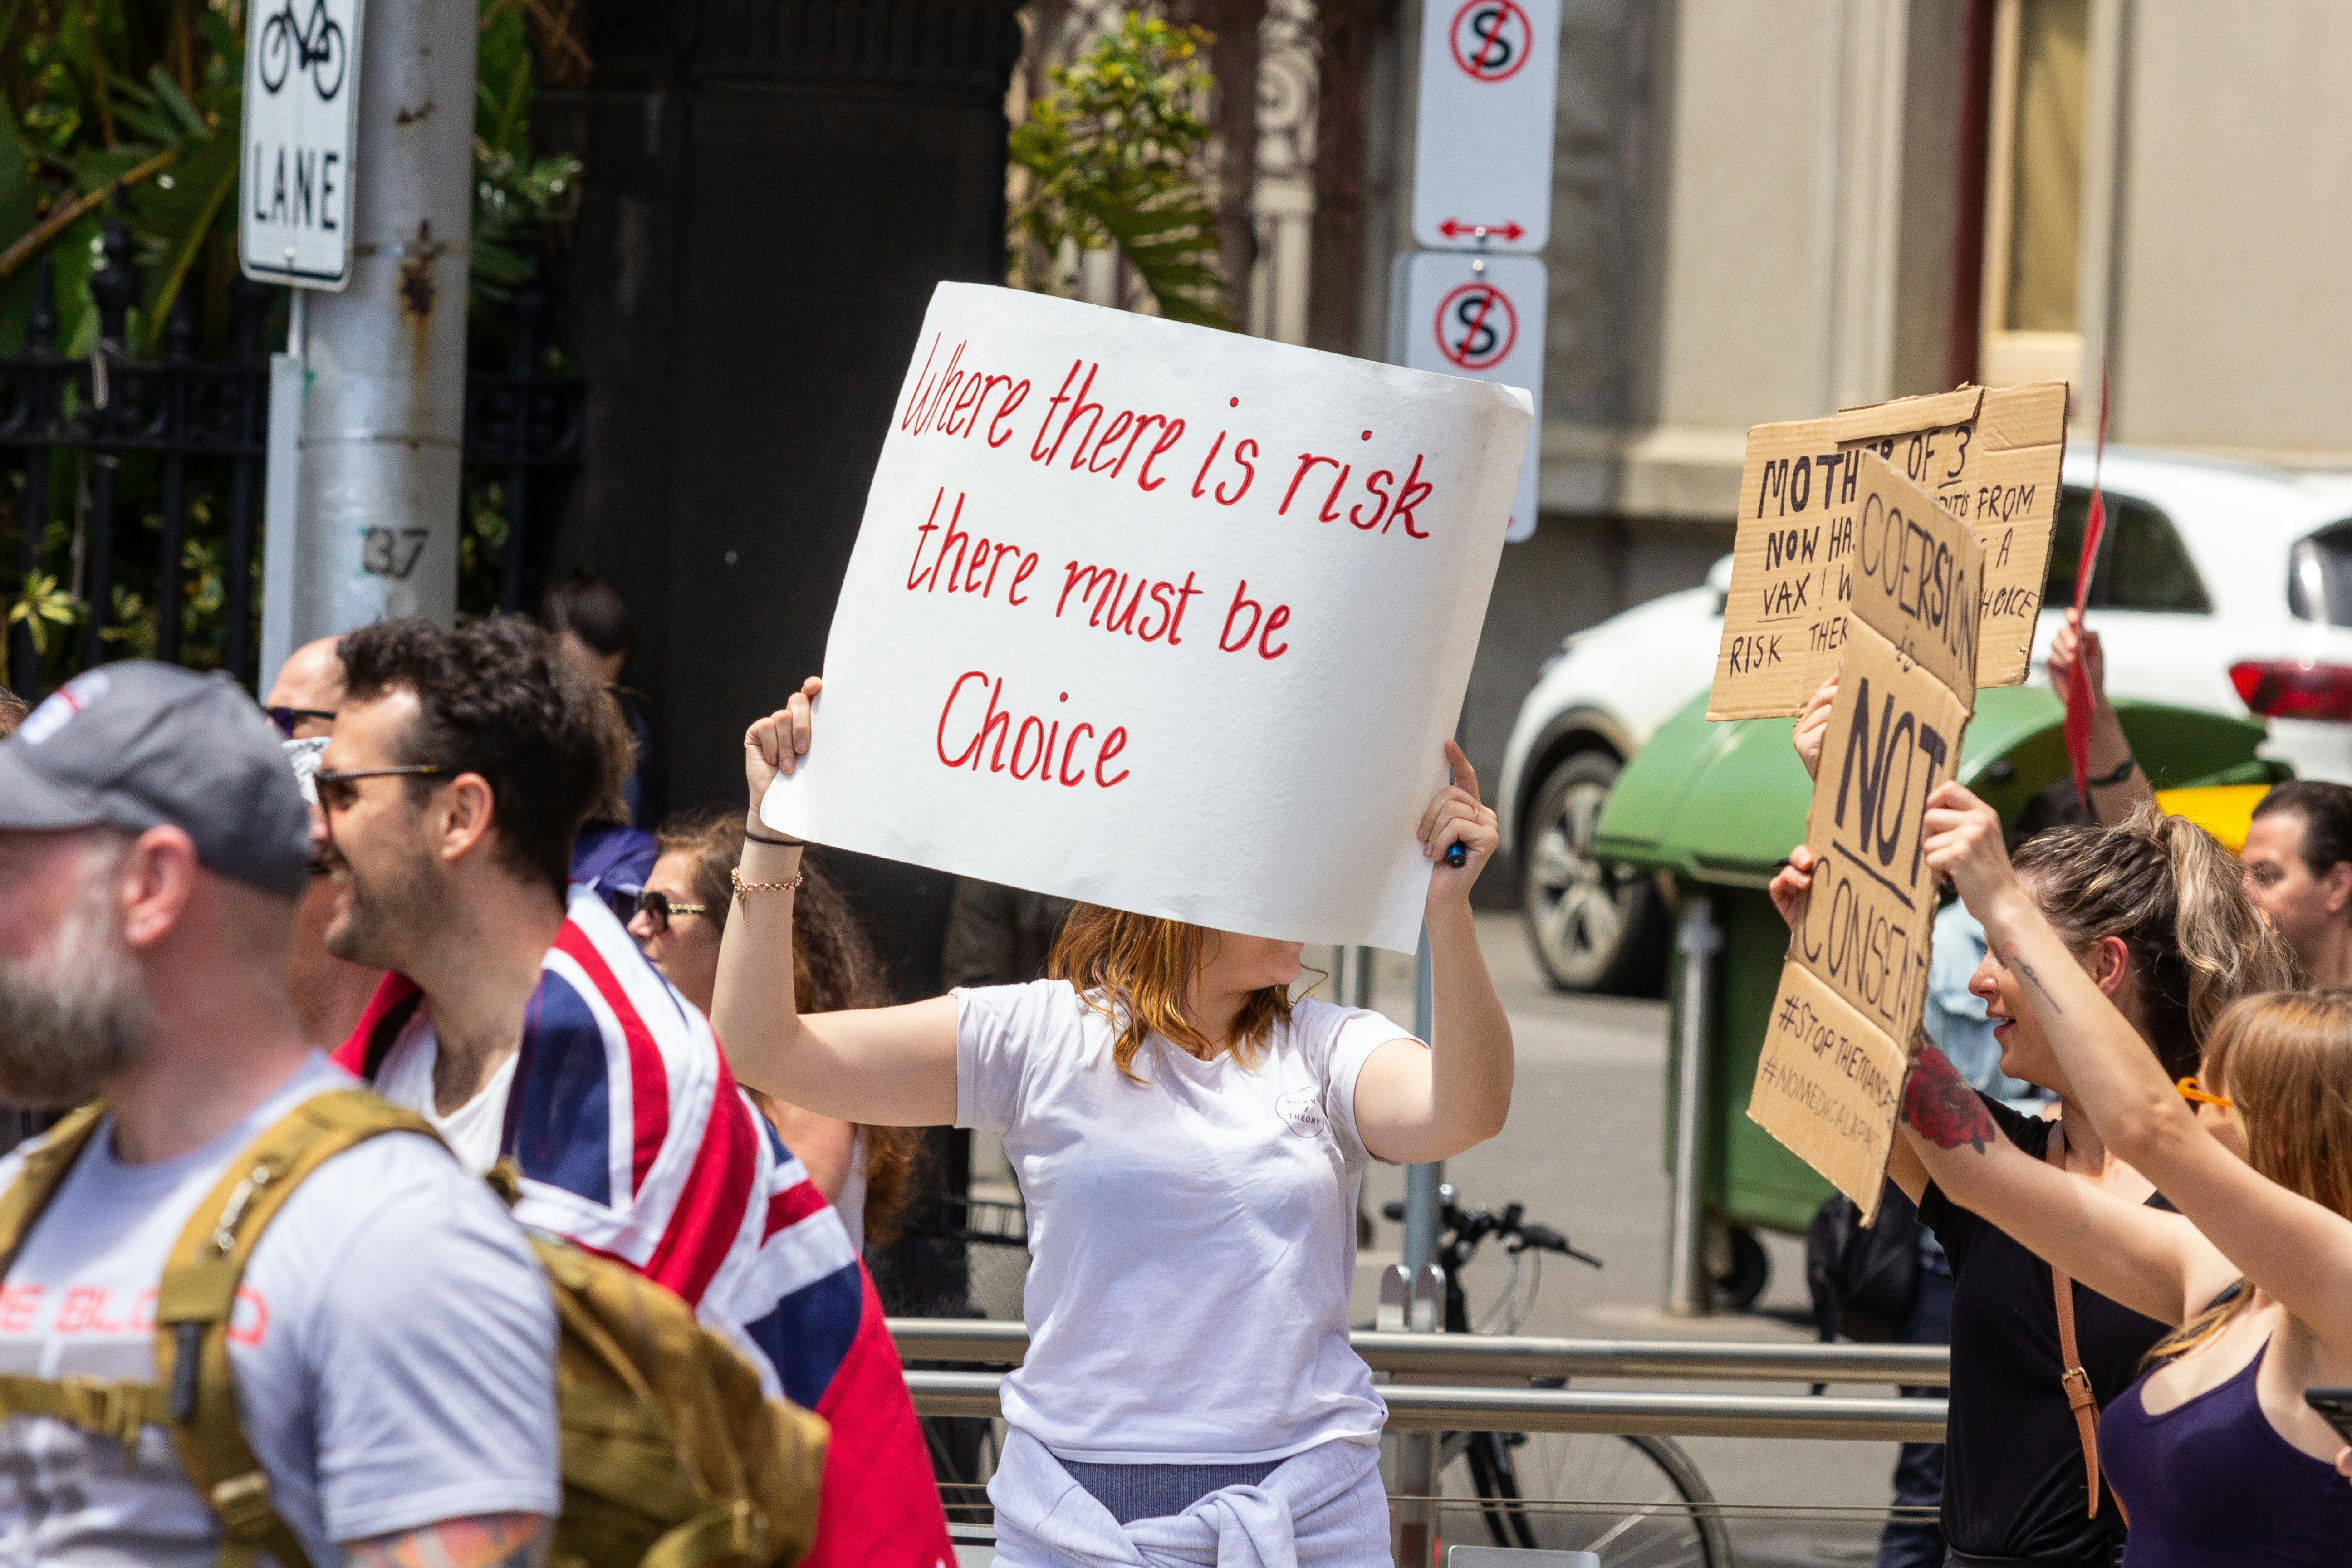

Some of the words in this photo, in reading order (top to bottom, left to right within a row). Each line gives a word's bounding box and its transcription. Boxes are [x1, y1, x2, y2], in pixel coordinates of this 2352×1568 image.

[255, 142, 338, 230] LANE
[901, 333, 1030, 448] Where
[1030, 359, 1186, 492] there
[1191, 397, 1259, 506] is
[1278, 431, 1433, 539] risk
[1757, 438, 1895, 519] MOTHR
[1907, 429, 1941, 482] OF
[1947, 426, 1972, 479] 3
[906, 487, 1039, 607] there
[1055, 560, 1204, 646] must
[1218, 580, 1290, 660] be
[1764, 572, 1811, 616] VAX
[1996, 526, 2013, 569] A
[1766, 526, 1820, 571] NOW
[1828, 516, 1855, 562] HA
[1977, 484, 2036, 522] FROM
[1730, 635, 1782, 677] RISK
[1809, 616, 1851, 655] THER
[1980, 585, 2040, 619] HOICE
[937, 671, 1130, 788] Choice
[1835, 677, 1947, 888] NOT
[1288, 1113, 1320, 1126] THEORY
